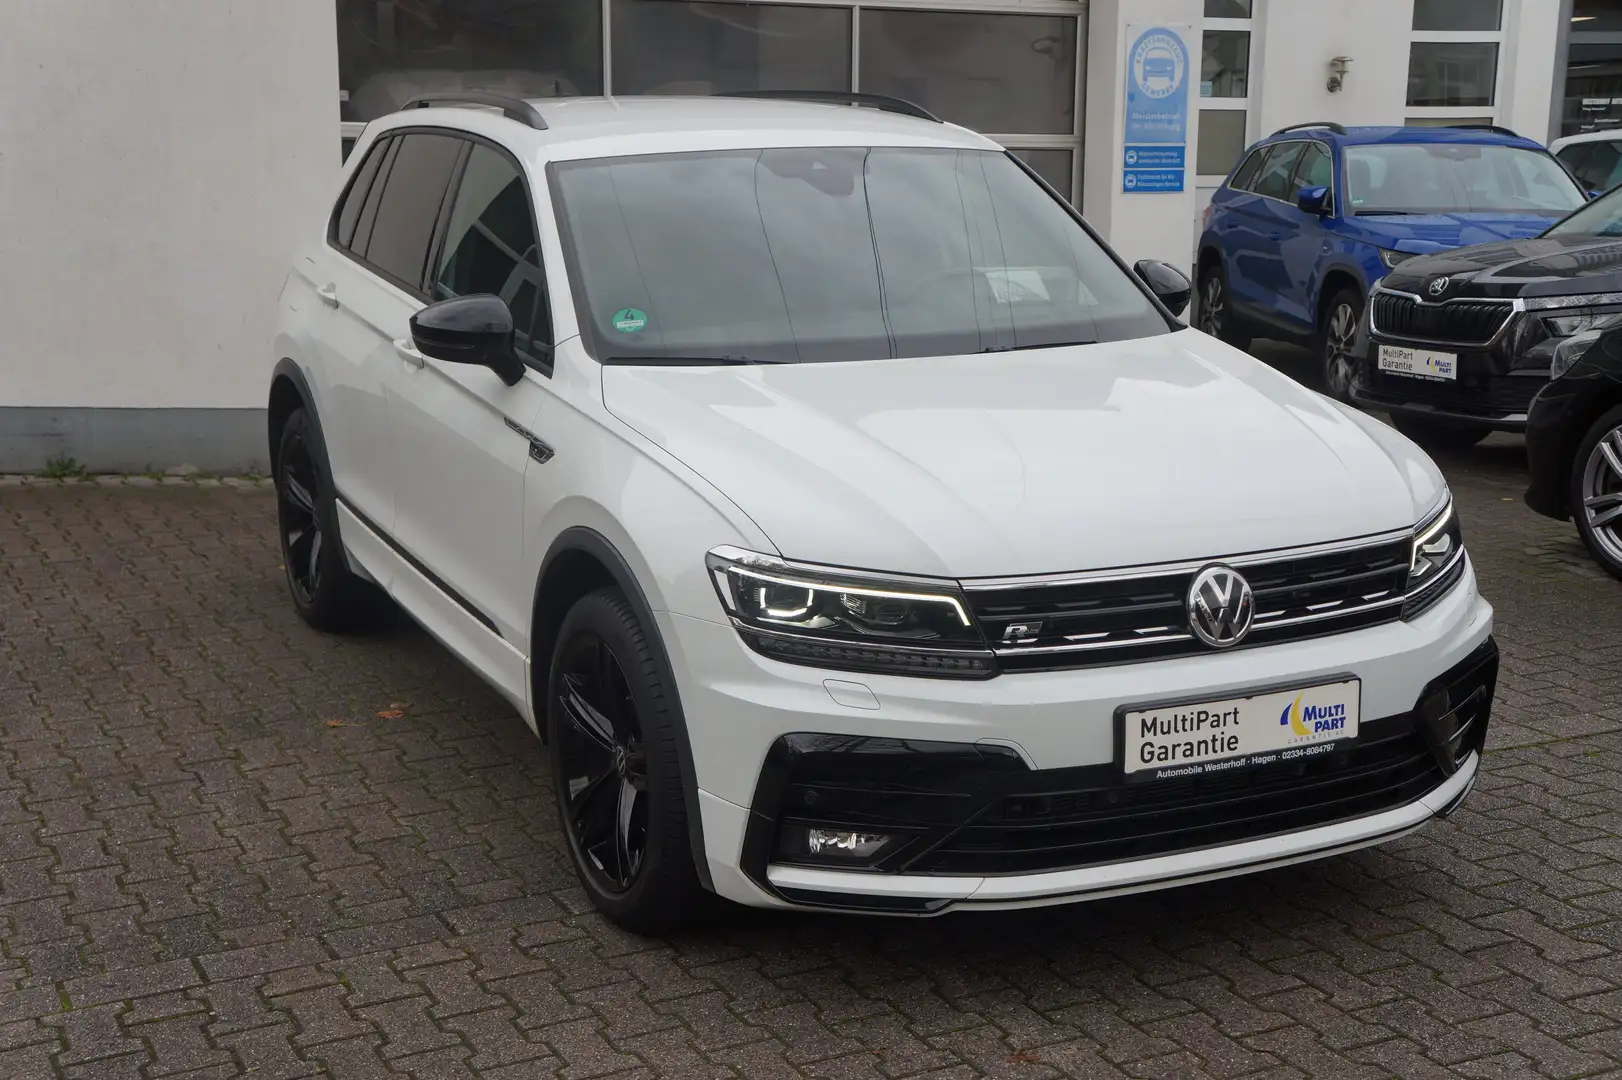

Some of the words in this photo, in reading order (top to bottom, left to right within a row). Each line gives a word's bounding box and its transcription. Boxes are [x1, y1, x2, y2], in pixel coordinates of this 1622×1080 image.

[624, 309, 635, 320] 4
[1383, 348, 1413, 360] MultiPart
[1382, 358, 1413, 371] Garantie
[1141, 707, 1240, 738] MultiPart
[1314, 716, 1346, 733] PART
[1140, 731, 1239, 764] Garantie
[1156, 765, 1203, 779] Automobile
[1204, 758, 1246, 772] Westerhoff
[1251, 754, 1277, 765] Hagen
